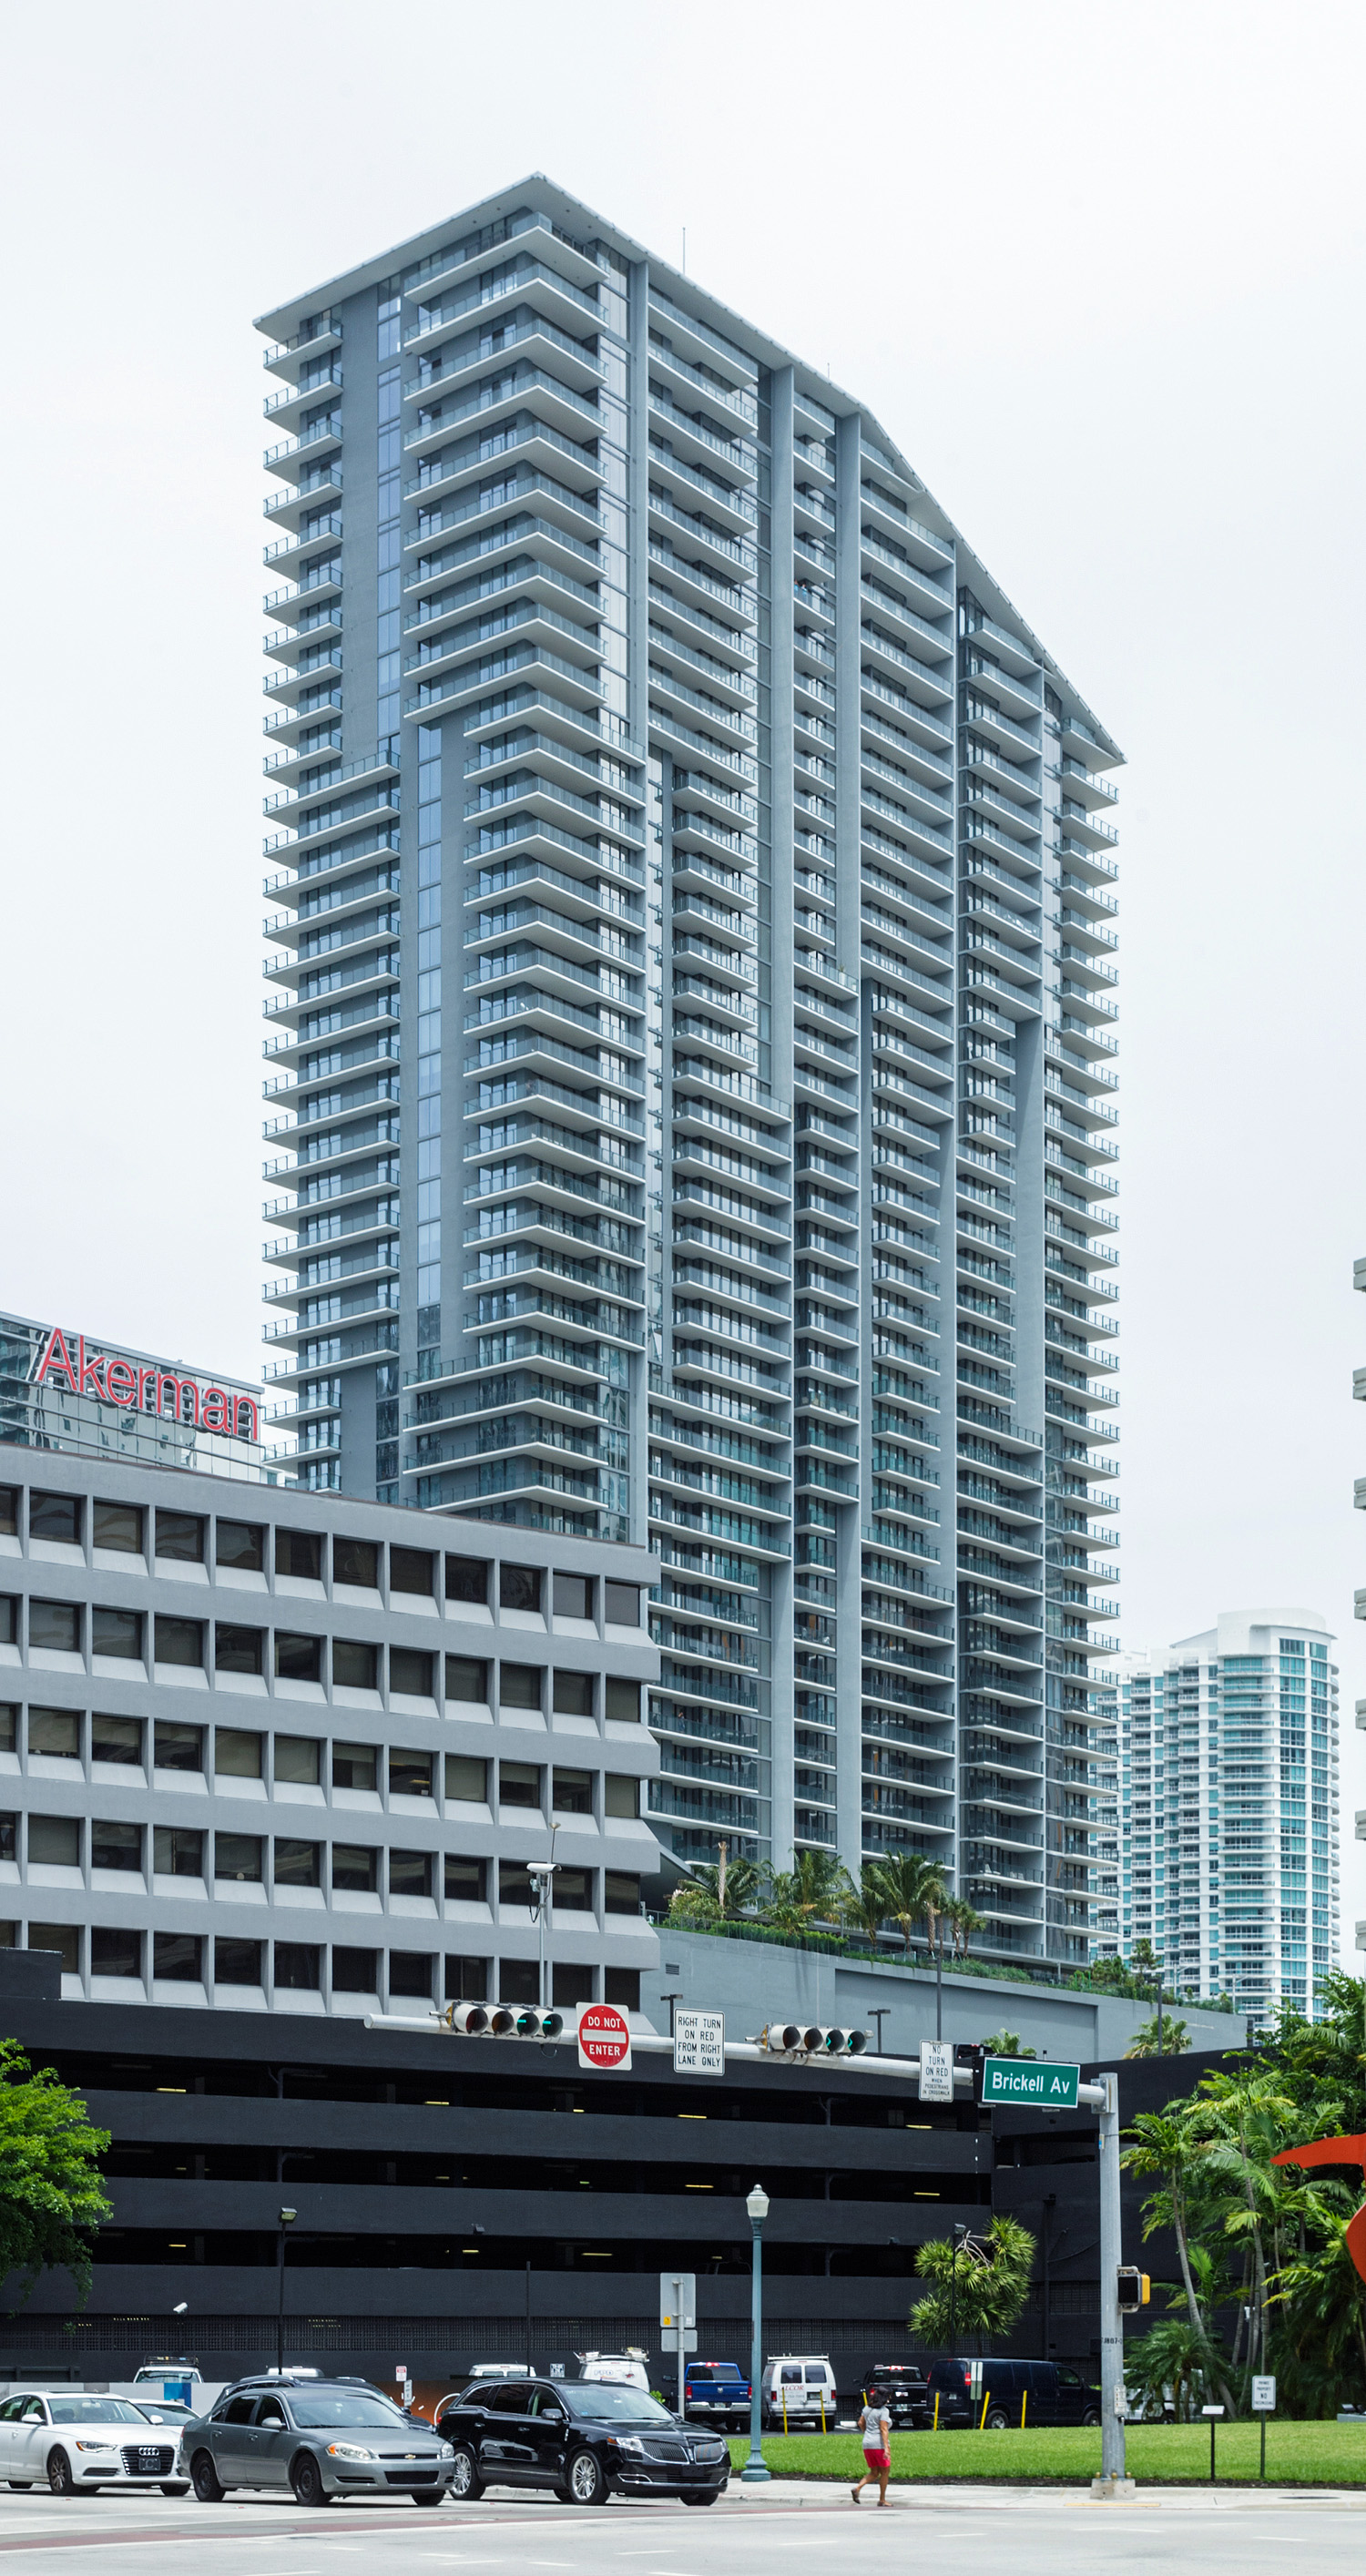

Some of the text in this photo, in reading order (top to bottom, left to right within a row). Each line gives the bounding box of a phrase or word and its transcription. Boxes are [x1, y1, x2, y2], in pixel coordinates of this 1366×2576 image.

[37, 1328, 258, 1441] Akerman
[587, 2016, 621, 2029] DO NOT
[678, 2016, 721, 2029] RIGHT TURN
[685, 2030, 715, 2041] ON RED
[589, 2044, 620, 2056] ENTER
[678, 2042, 720, 2054] FROM RIGHT
[933, 2045, 941, 2054] NO
[678, 2055, 720, 2067] LANE ONLY
[929, 2056, 945, 2065] TURN
[925, 2067, 949, 2077] ON RED
[992, 2072, 1070, 2094] Brickell Av
